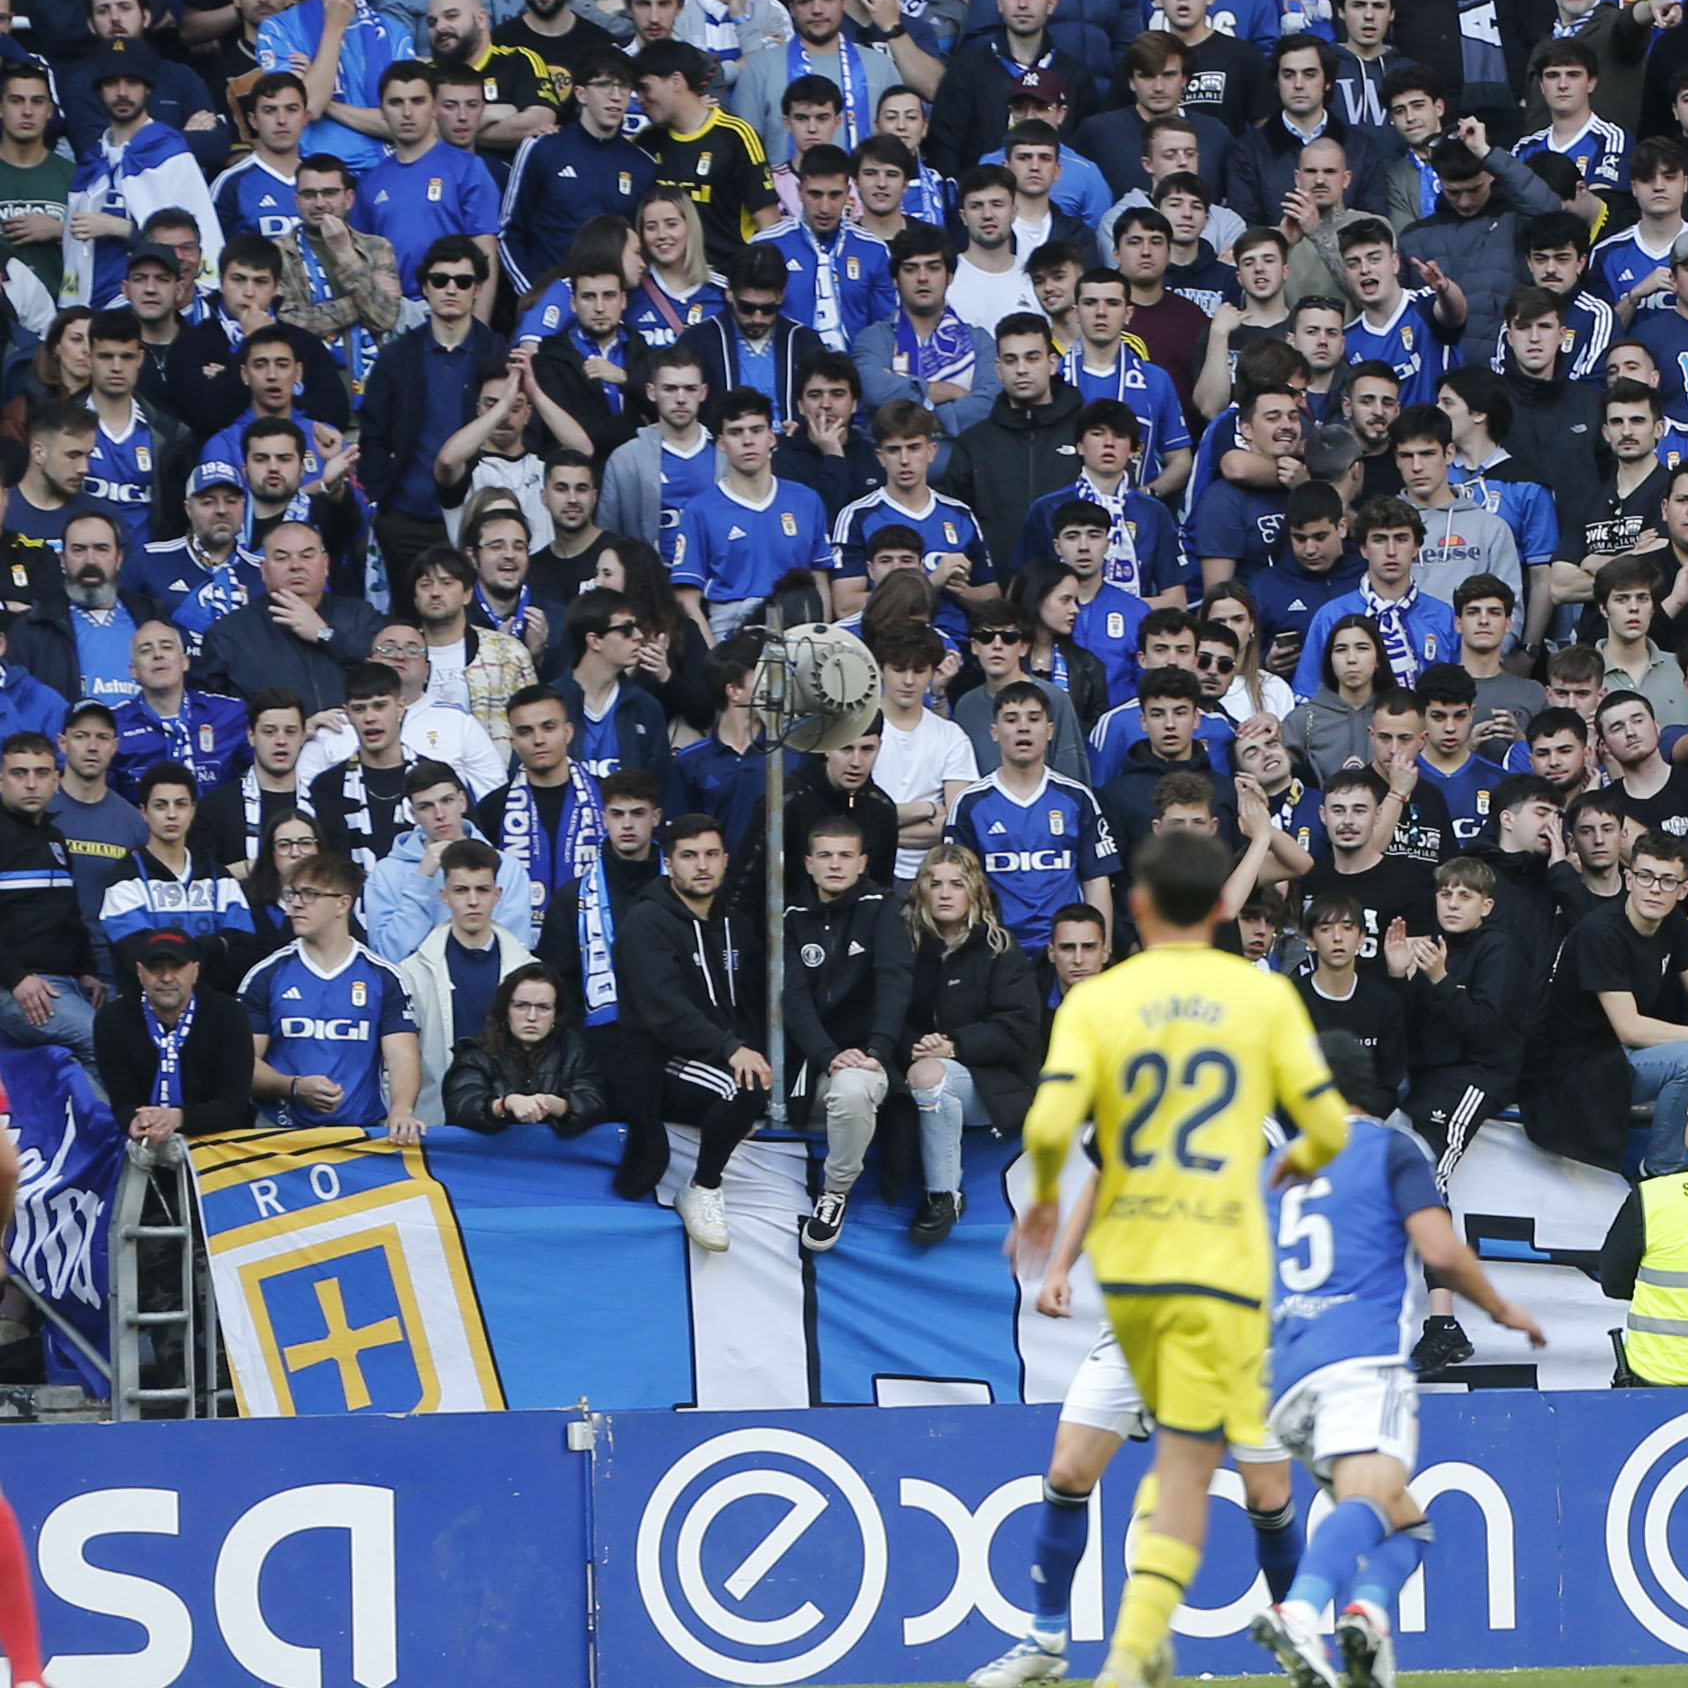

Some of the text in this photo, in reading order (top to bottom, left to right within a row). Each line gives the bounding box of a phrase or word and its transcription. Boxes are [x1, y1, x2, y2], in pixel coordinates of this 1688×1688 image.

[984, 850, 1074, 875] DIGI
[279, 1014, 371, 1044] DIGI
[1137, 996, 1226, 1028] TIAGO
[1121, 1047, 1243, 1148] 22
[249, 1161, 342, 1219] R O
[1276, 1177, 1335, 1294] 5
[28, 1483, 396, 1688] sa
